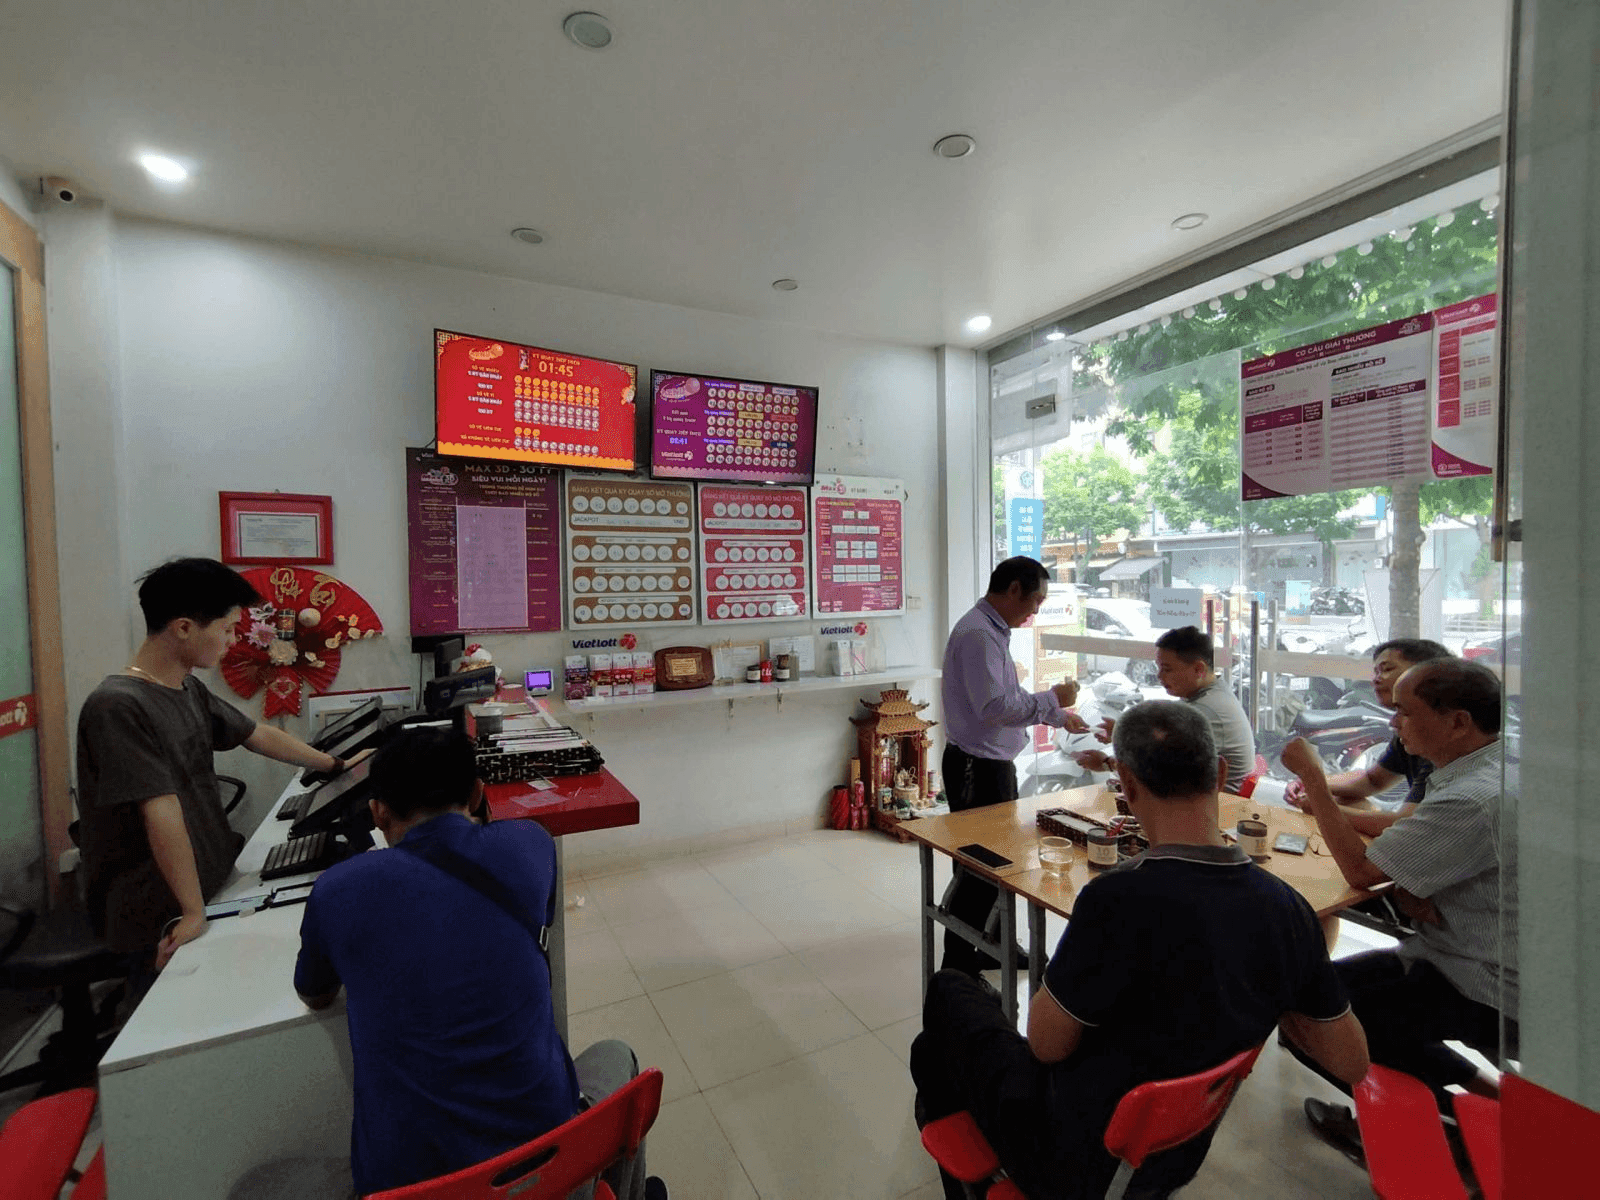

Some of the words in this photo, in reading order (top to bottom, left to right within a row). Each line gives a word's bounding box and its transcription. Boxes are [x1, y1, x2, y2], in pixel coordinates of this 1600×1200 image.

[538, 361, 574, 377] 01:45
[464, 464, 491, 473] MAX
[495, 465, 510, 473] 3D
[590, 486, 603, 494] KẾT
[627, 488, 645, 496] QUAY
[820, 624, 853, 635] Vietlott
[572, 638, 617, 649] Vietlott
